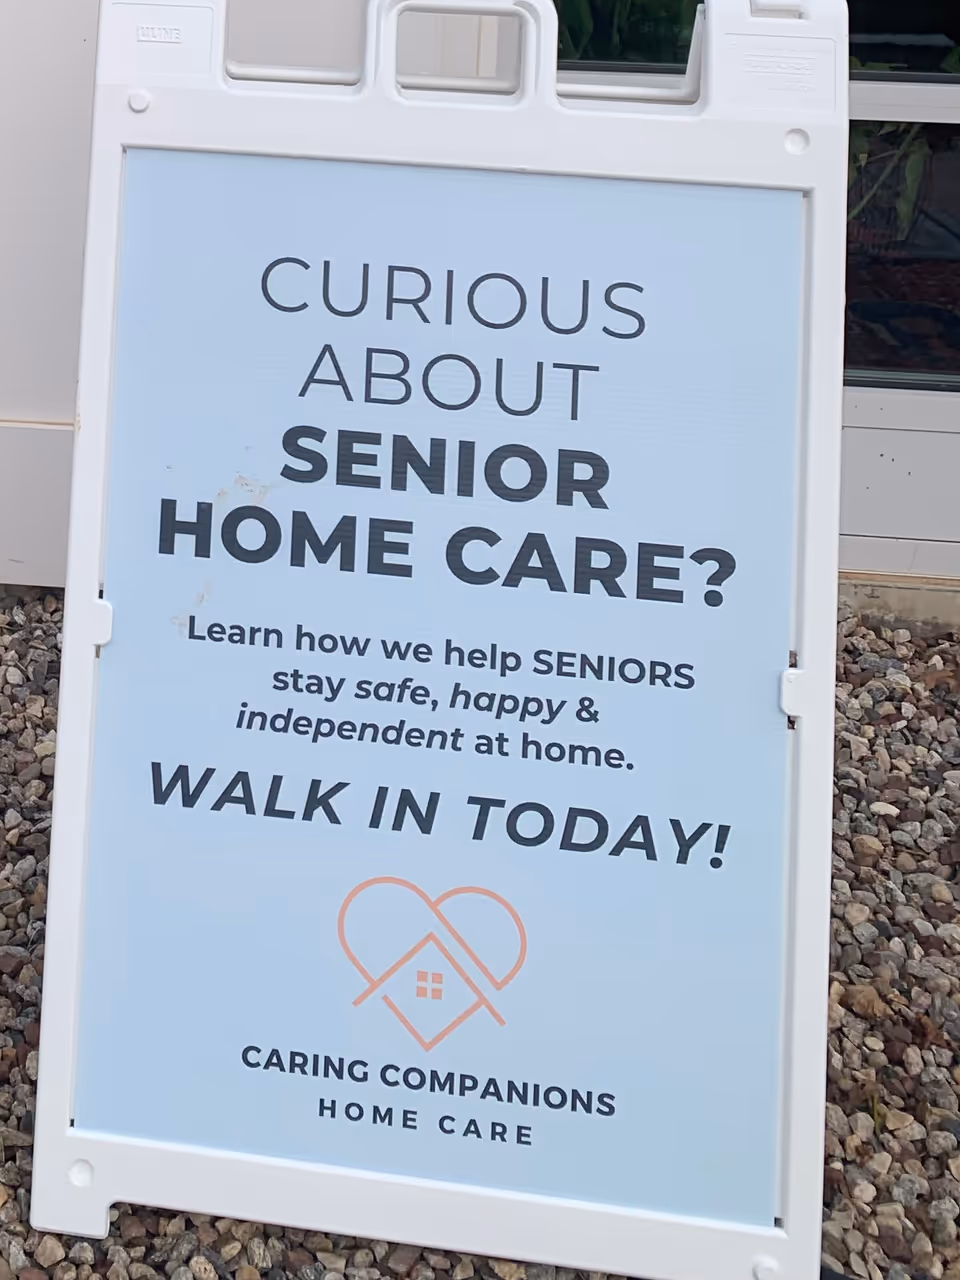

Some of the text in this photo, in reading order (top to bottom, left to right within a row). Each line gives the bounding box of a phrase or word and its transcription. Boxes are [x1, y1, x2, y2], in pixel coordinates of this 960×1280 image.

[262, 257, 645, 339] CURIOUS
[298, 344, 599, 420] ABOUT
[280, 425, 609, 509] SENIOR
[159, 498, 737, 607] HOME CARE?
[189, 615, 694, 689] Learn how we help SENIORS
[273, 669, 599, 725] stay safe, happy &
[236, 701, 635, 771] independent at home.
[151, 762, 731, 870] WALK IN TODAY!
[242, 1046, 615, 1116] CARING COMPANIONS
[319, 1098, 531, 1146] HOME CARE
